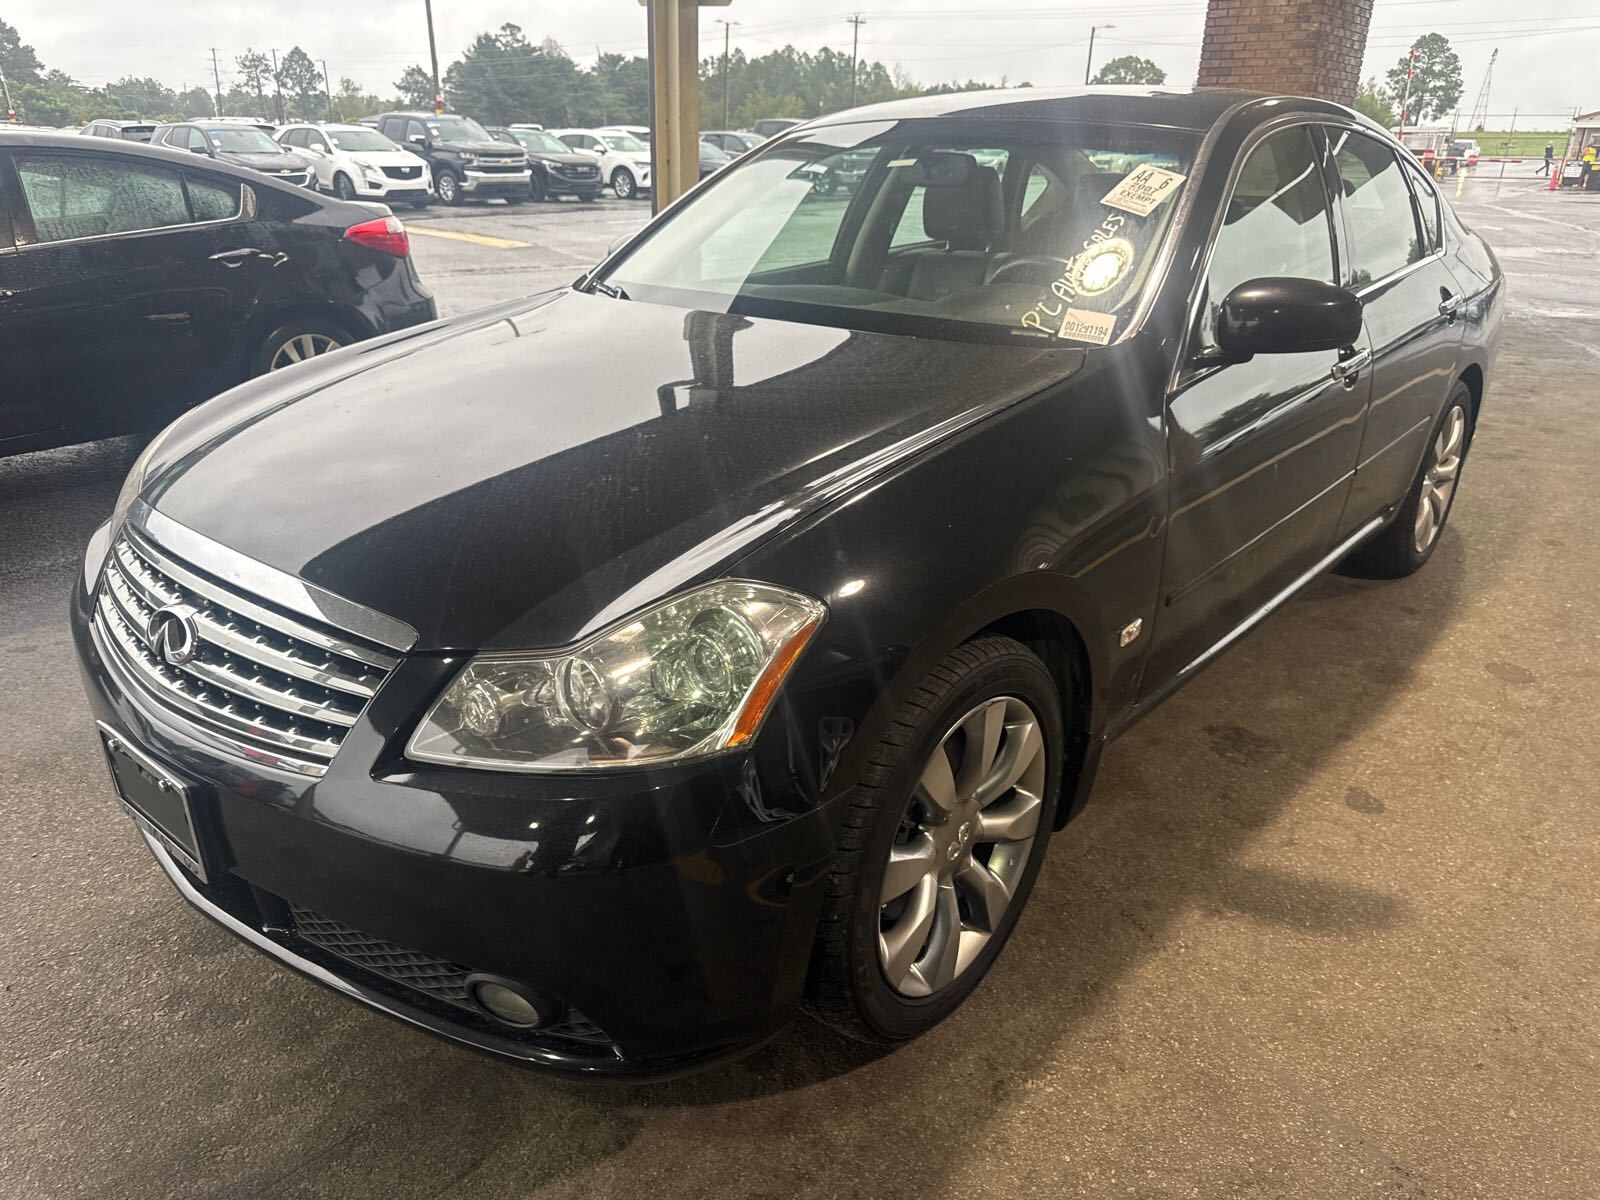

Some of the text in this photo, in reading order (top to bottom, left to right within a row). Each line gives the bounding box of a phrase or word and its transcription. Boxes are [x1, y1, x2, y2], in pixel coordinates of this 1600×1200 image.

[1131, 169, 1154, 184] AA
[1159, 177, 1173, 190] 6
[1129, 182, 1158, 194] 2007
[1119, 189, 1158, 205] EXEMPT
